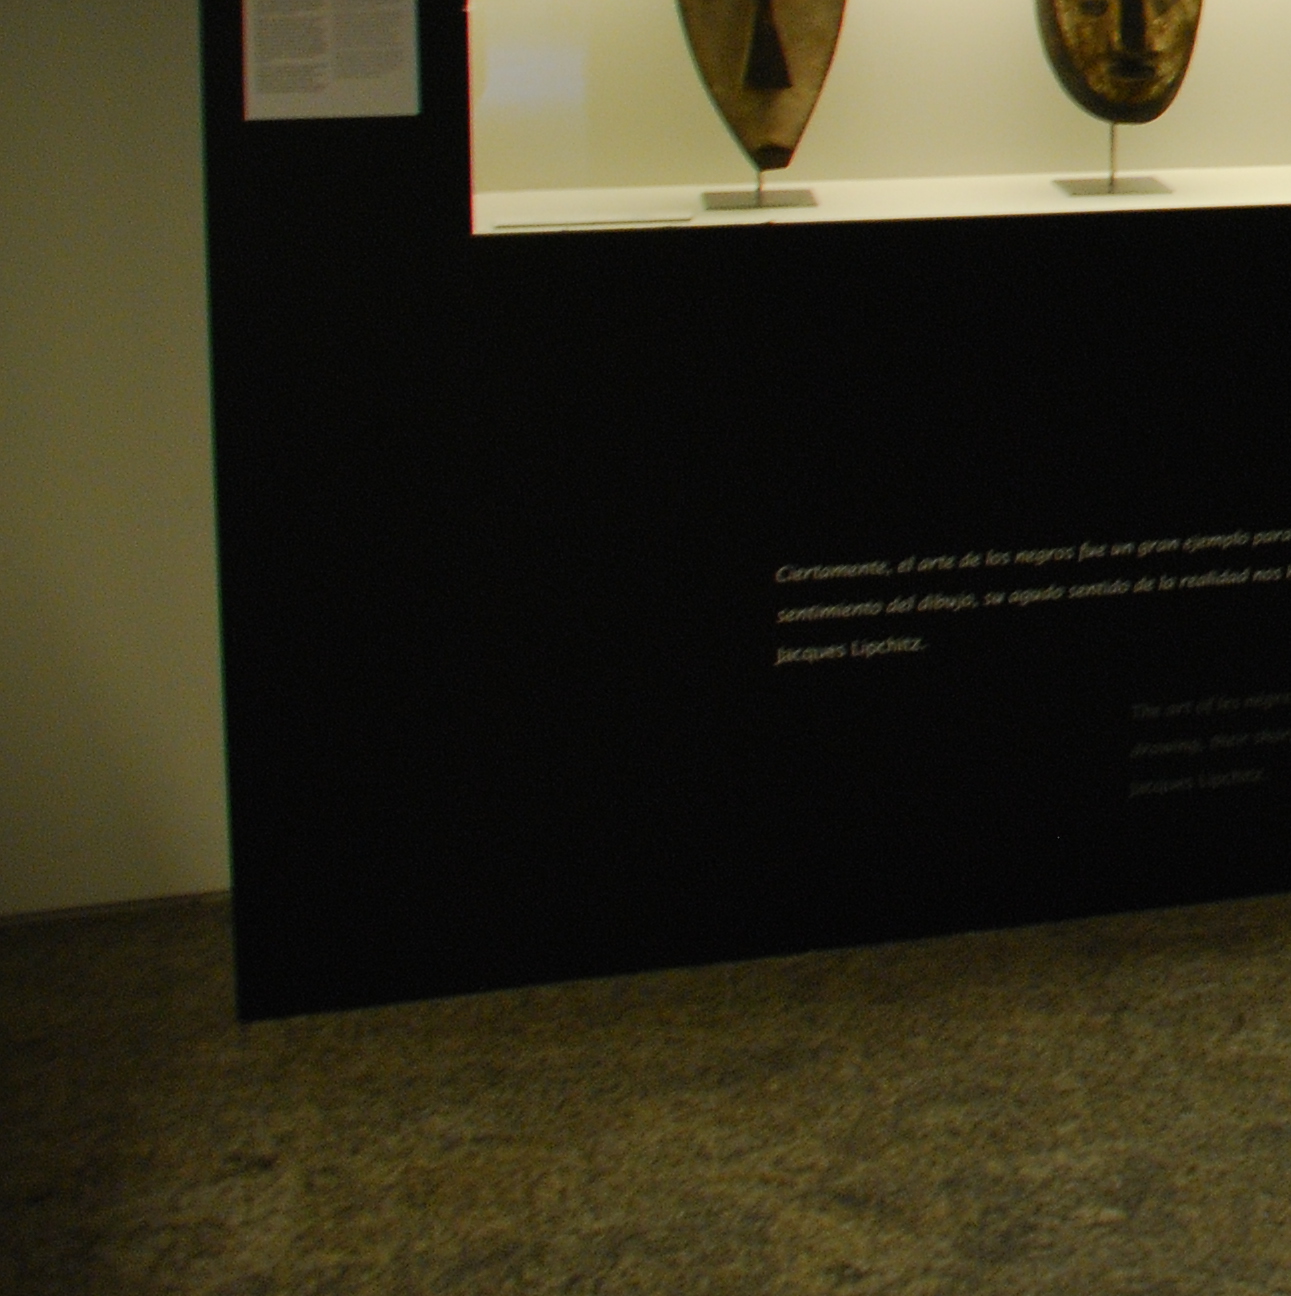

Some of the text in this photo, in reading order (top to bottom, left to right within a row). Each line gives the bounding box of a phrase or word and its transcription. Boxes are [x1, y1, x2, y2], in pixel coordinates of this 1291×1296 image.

[775, 561, 892, 583] Ciertamente,
[897, 556, 915, 573] el
[917, 555, 956, 572] arte
[958, 551, 982, 568] de
[985, 549, 1011, 566] los
[1014, 546, 1075, 566] negros
[1078, 541, 1108, 562] fue
[1110, 542, 1135, 556] un
[1137, 538, 1180, 557] gran
[1182, 530, 1250, 553] ejemplo
[777, 601, 883, 623] sentimiento
[886, 595, 918, 613] del
[983, 592, 1005, 606] su
[1008, 584, 1065, 606] agudo
[1068, 579, 1131, 599] sentido
[1133, 576, 1155, 593] de
[1158, 574, 1177, 590] la
[1179, 568, 1250, 588] realidad
[1252, 568, 1282, 581] nos
[774, 644, 847, 666] Jacques
